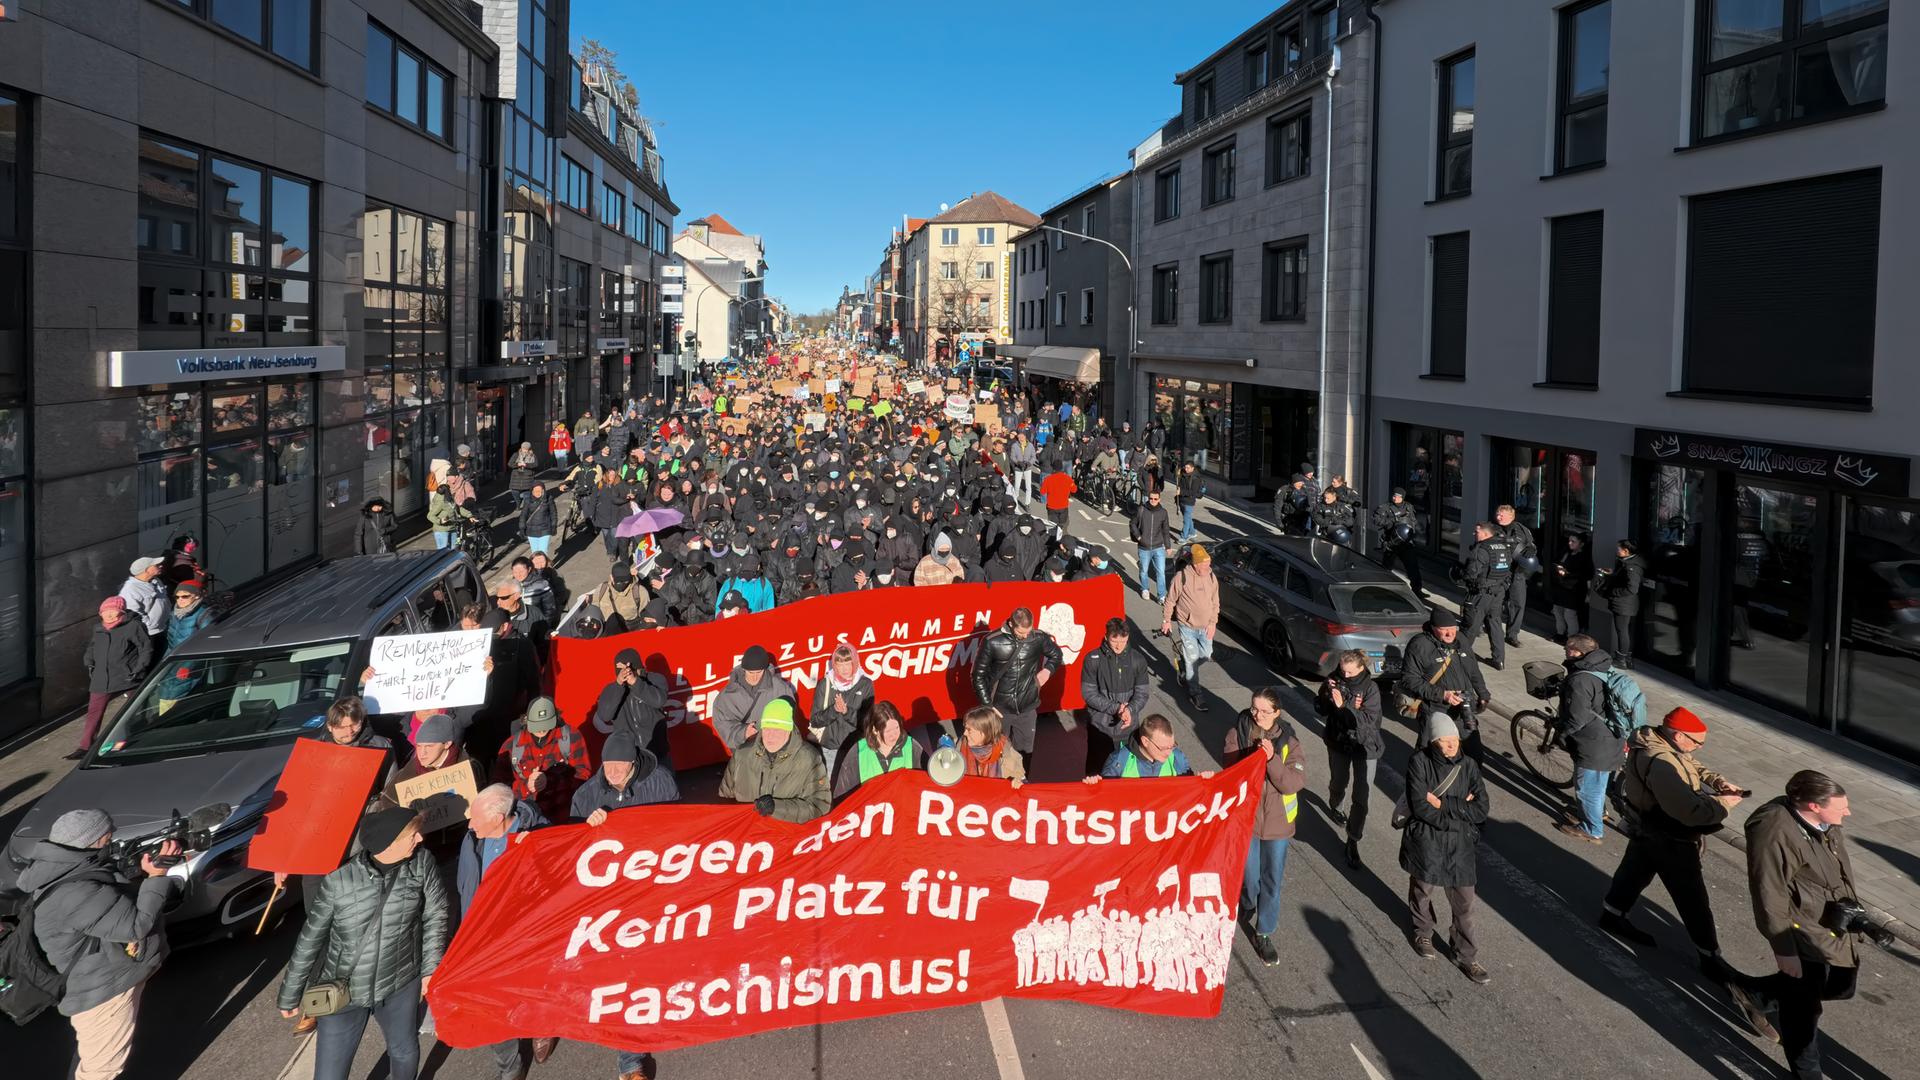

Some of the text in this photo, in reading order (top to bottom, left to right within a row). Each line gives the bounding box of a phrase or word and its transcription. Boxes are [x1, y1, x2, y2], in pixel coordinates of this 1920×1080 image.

[1001, 254, 1011, 322] COMMERZBANK
[176, 353, 318, 374] Volksbank Neu-Isenburg
[778, 609, 992, 661] ZUSAMMEN
[403, 768, 468, 799] AUF KEINEN
[576, 838, 775, 888] Gegen
[793, 800, 895, 856] den
[564, 868, 990, 960] Kein Platz für
[588, 948, 971, 1026] Faschismus!
